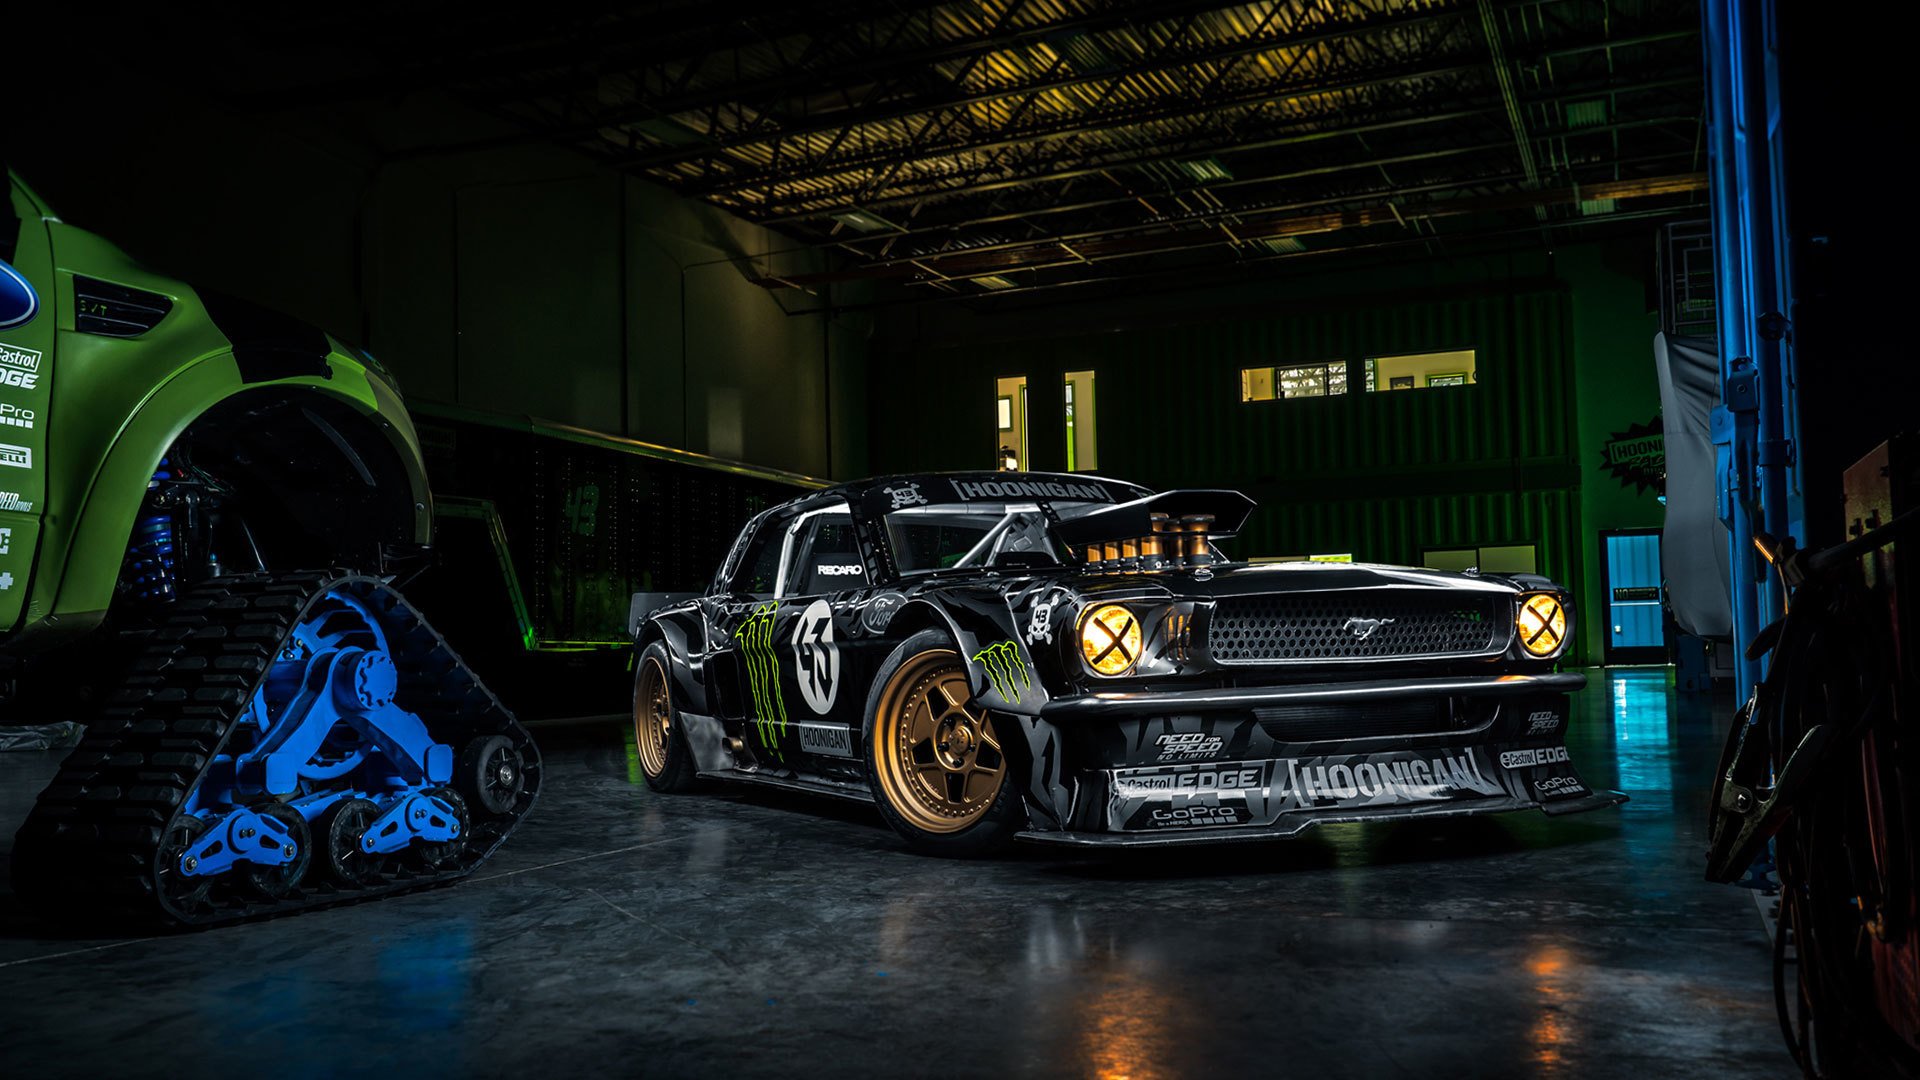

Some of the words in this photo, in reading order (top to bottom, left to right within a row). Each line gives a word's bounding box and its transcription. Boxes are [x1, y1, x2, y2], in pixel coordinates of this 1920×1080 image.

[817, 564, 863, 576] RECARO
[869, 598, 898, 626] For
[1035, 609, 1048, 624] 43
[1154, 733, 1206, 746] NEED
[1162, 742, 1224, 755] SPEED
[1178, 752, 1217, 760] LIMITS
[1510, 752, 1535, 766] Castrol
[1128, 776, 1171, 791] Castrol
[1177, 768, 1259, 791] EDGE
[1534, 776, 1578, 791] GoPro
[1152, 806, 1236, 820] GoPro
